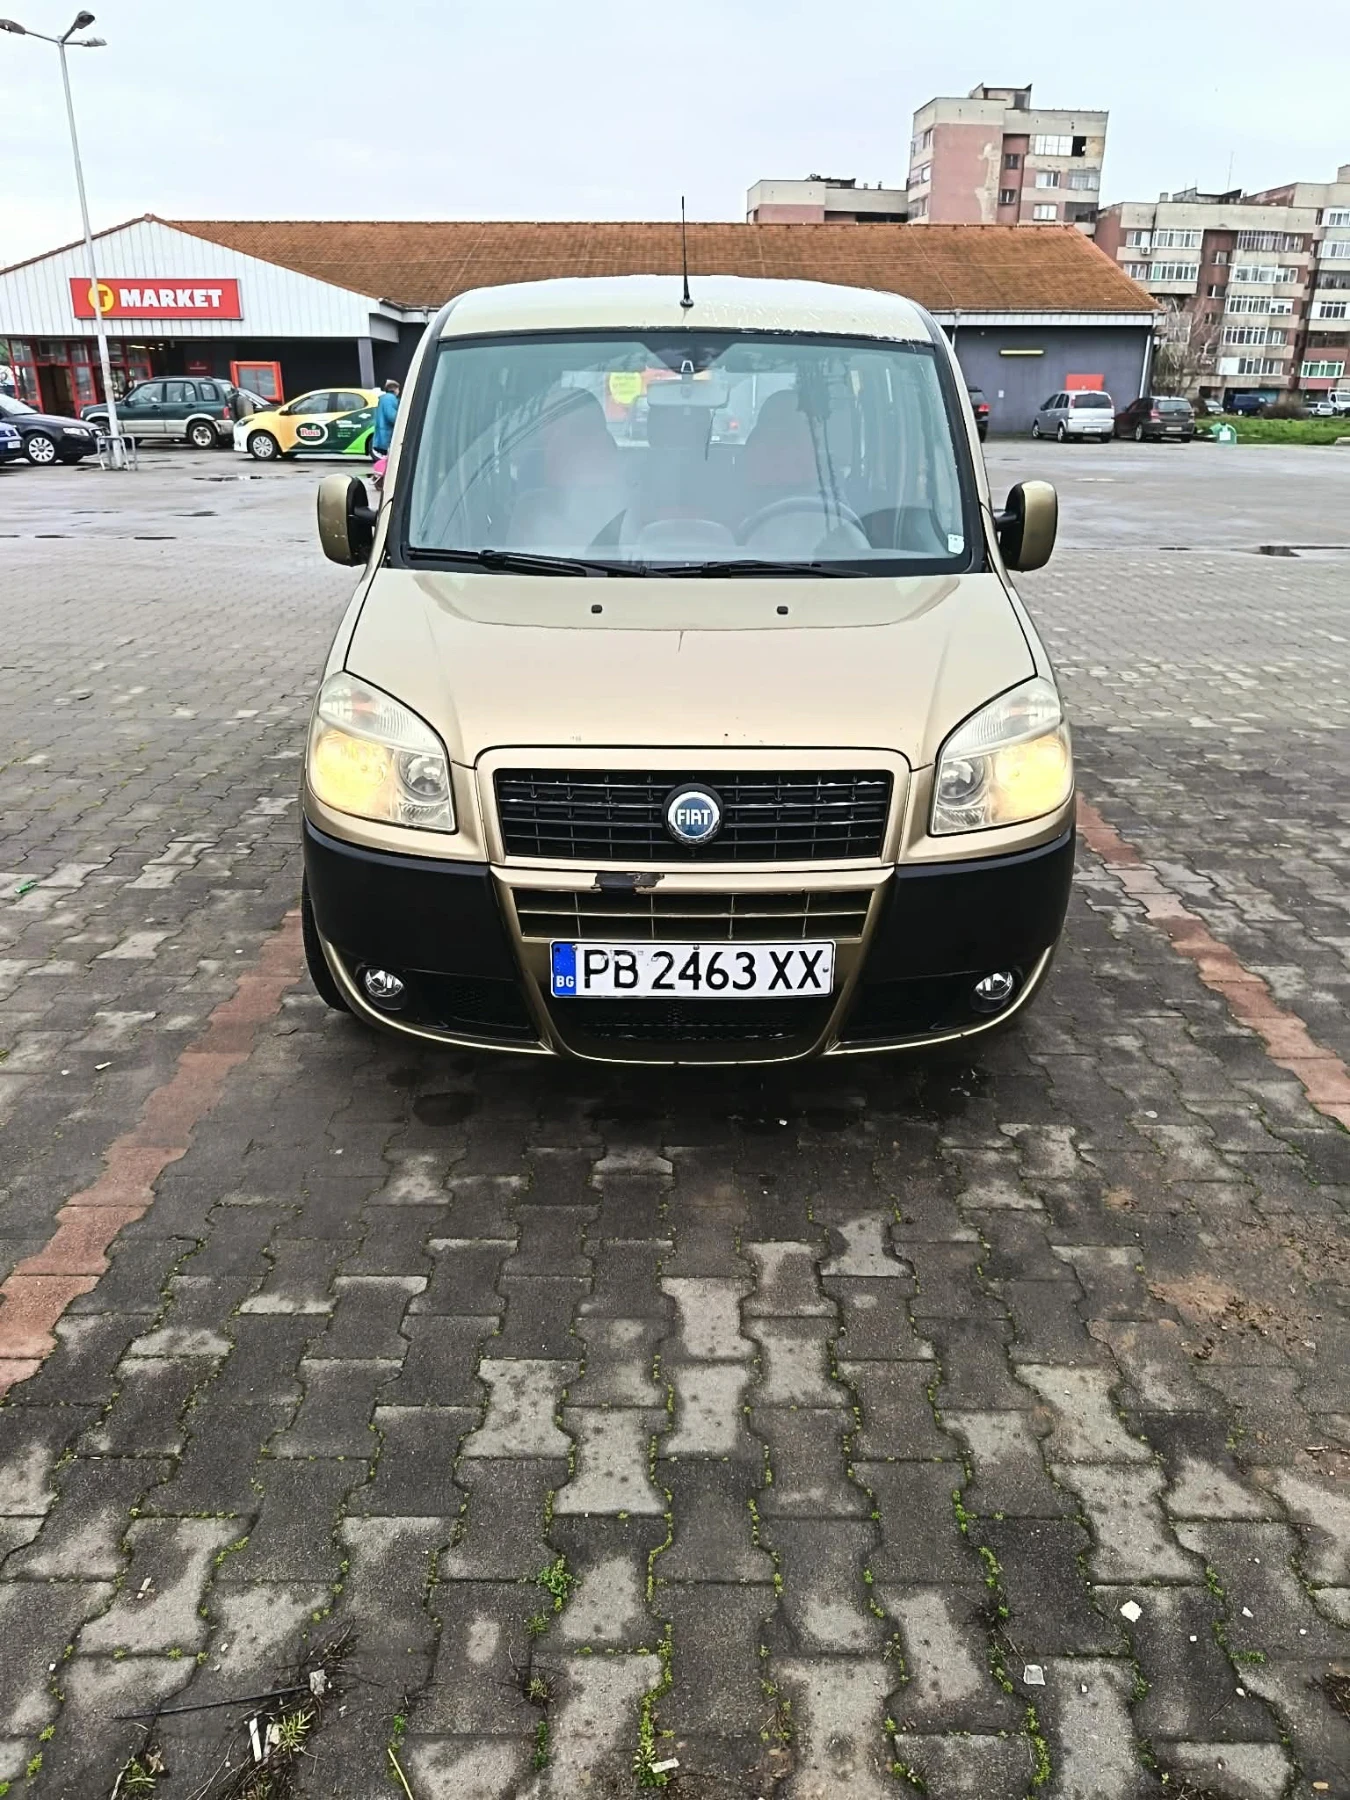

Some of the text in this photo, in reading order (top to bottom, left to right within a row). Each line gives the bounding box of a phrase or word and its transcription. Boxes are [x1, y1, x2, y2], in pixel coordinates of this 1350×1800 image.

[119, 288, 222, 308] MARKET
[677, 808, 711, 825] FIAT
[583, 950, 824, 990] PB 2463 XX
[556, 975, 575, 988] BG
